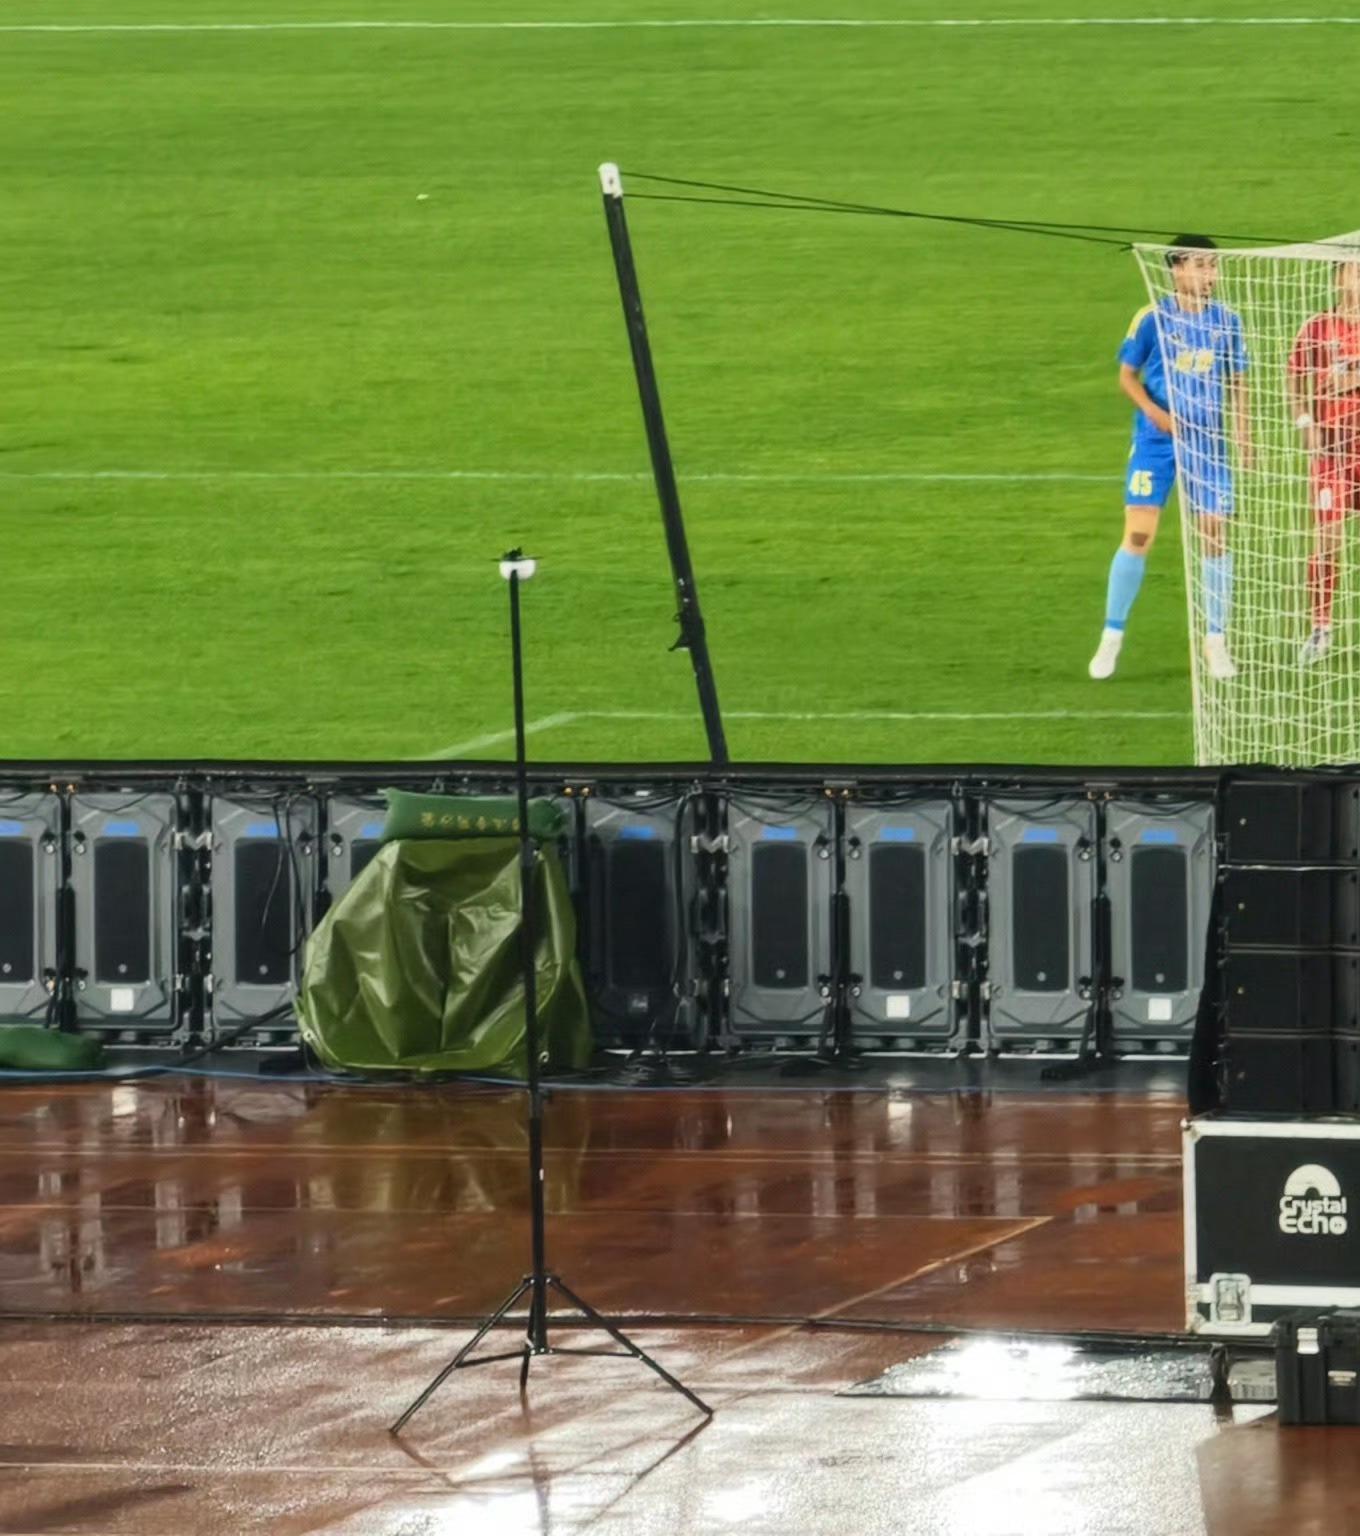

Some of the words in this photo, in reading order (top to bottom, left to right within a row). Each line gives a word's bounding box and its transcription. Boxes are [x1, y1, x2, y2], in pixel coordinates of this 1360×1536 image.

[1129, 470, 1153, 496] 45
[1279, 1196, 1348, 1216] Crystal
[1278, 1213, 1348, 1235] Echo
